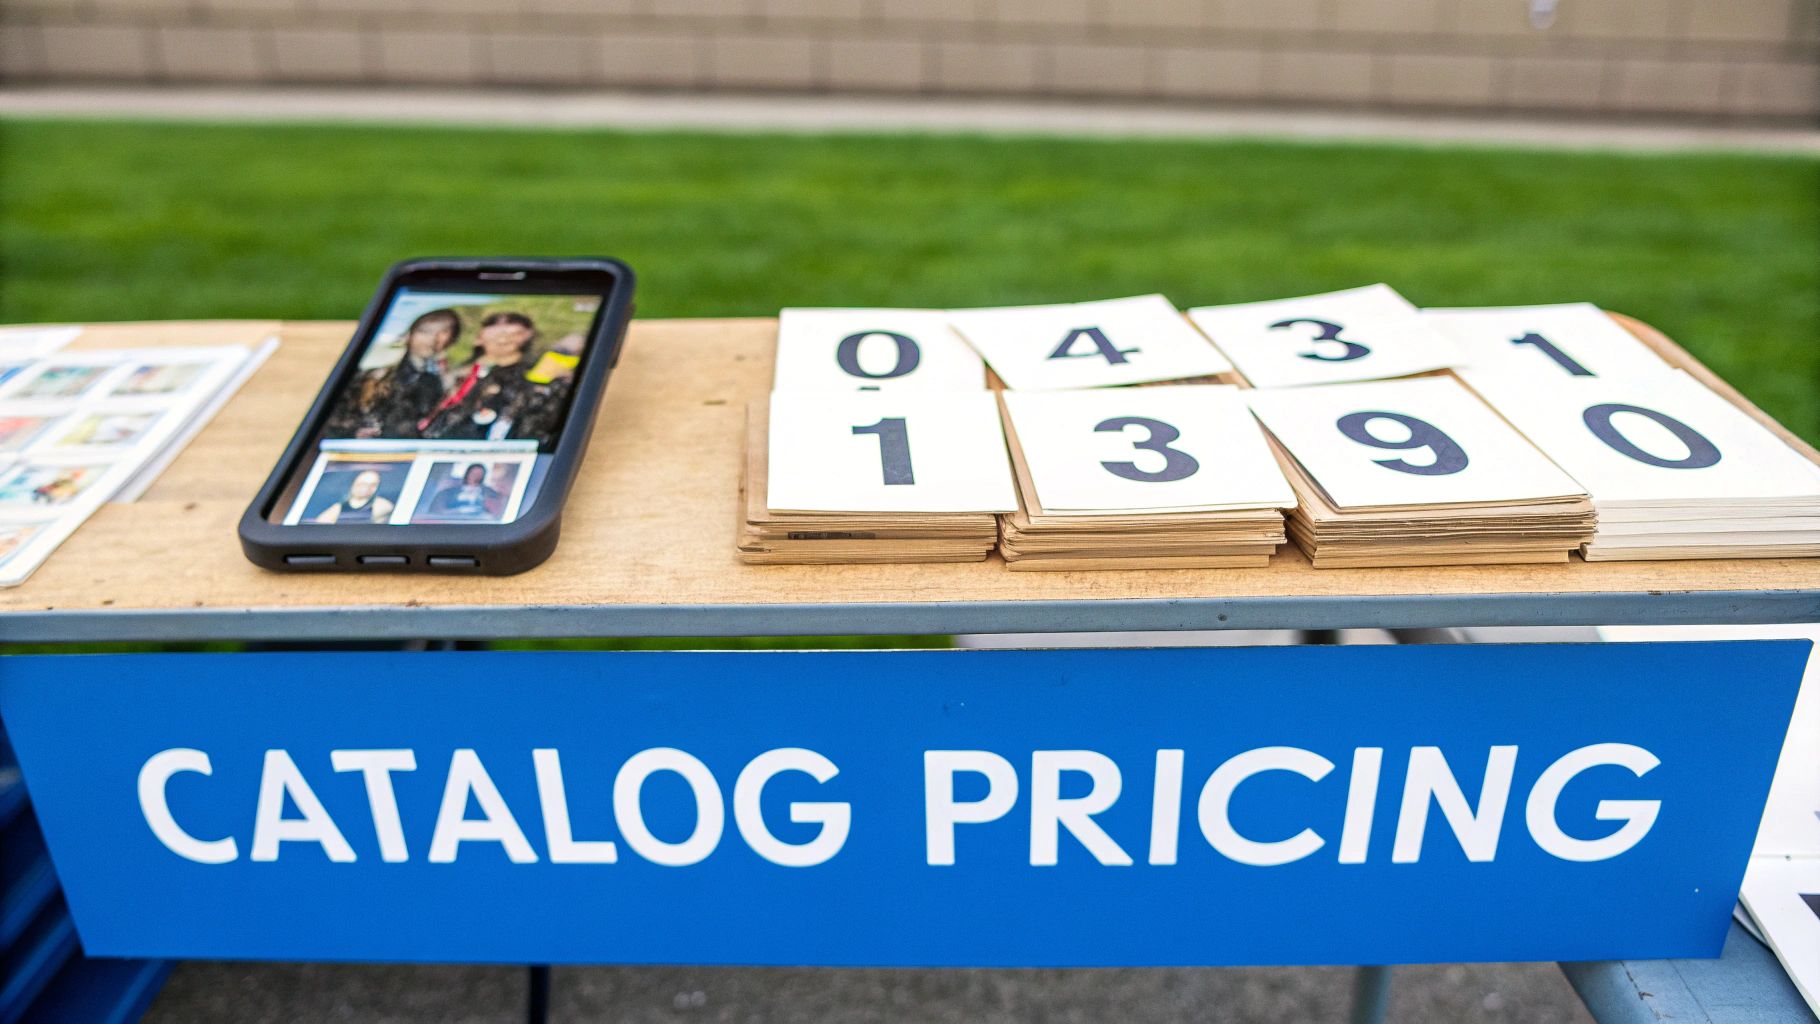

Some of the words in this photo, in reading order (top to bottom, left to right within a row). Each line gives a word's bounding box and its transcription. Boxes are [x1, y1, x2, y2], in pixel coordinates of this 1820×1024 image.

[836, 331, 921, 379] 0
[1046, 326, 1142, 365] 4
[1269, 318, 1371, 362] 3
[1510, 332, 1597, 377] 1
[851, 416, 915, 486] 1
[1093, 416, 1200, 483] 3
[1336, 410, 1469, 476] 9
[1582, 403, 1722, 469] 0
[137, 746, 852, 868] CATALOG
[923, 741, 1663, 867] PRICING
